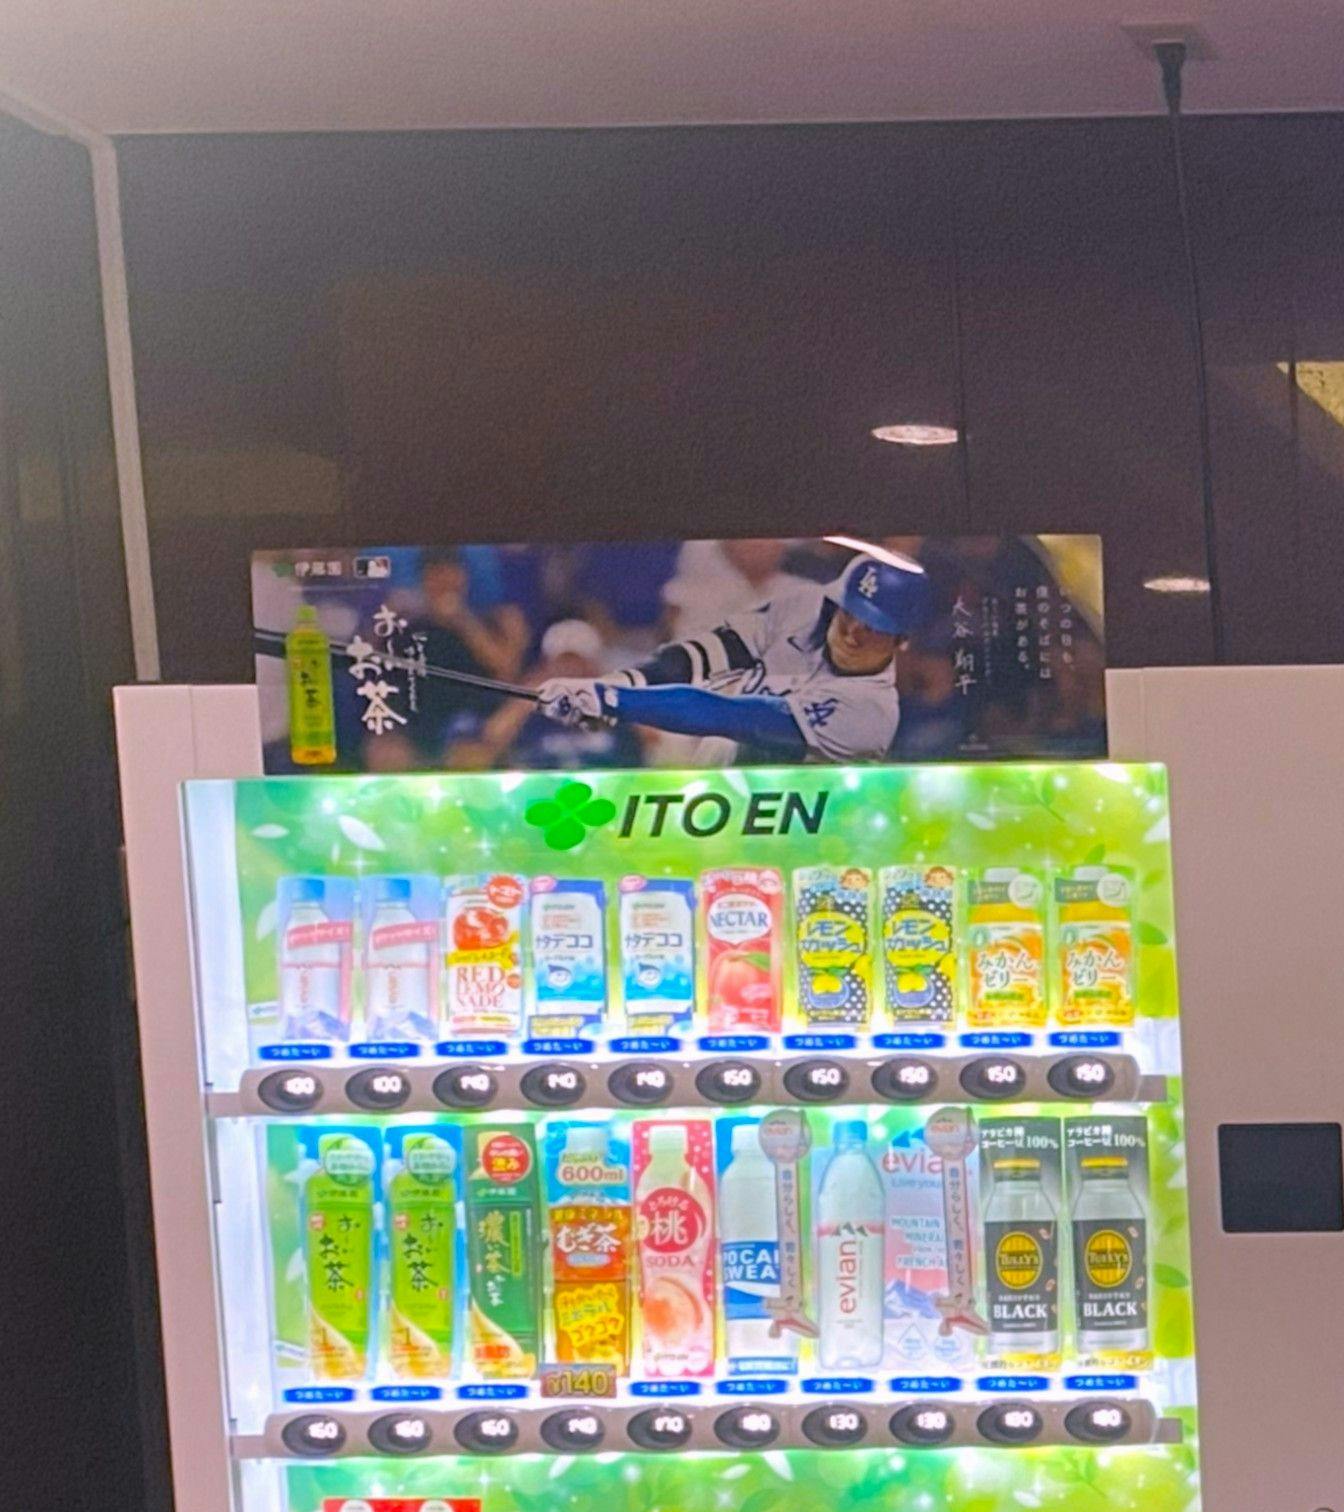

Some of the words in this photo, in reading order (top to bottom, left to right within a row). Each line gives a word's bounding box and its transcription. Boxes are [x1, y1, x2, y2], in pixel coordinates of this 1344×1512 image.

[618, 792, 732, 839] ITO
[741, 791, 830, 837] EN
[561, 1165, 625, 1183] 600ml
[652, 1210, 689, 1246] 桃
[836, 1239, 857, 1314] evian
[992, 1303, 1048, 1319] BLACK
[1082, 1301, 1138, 1318] BLACK
